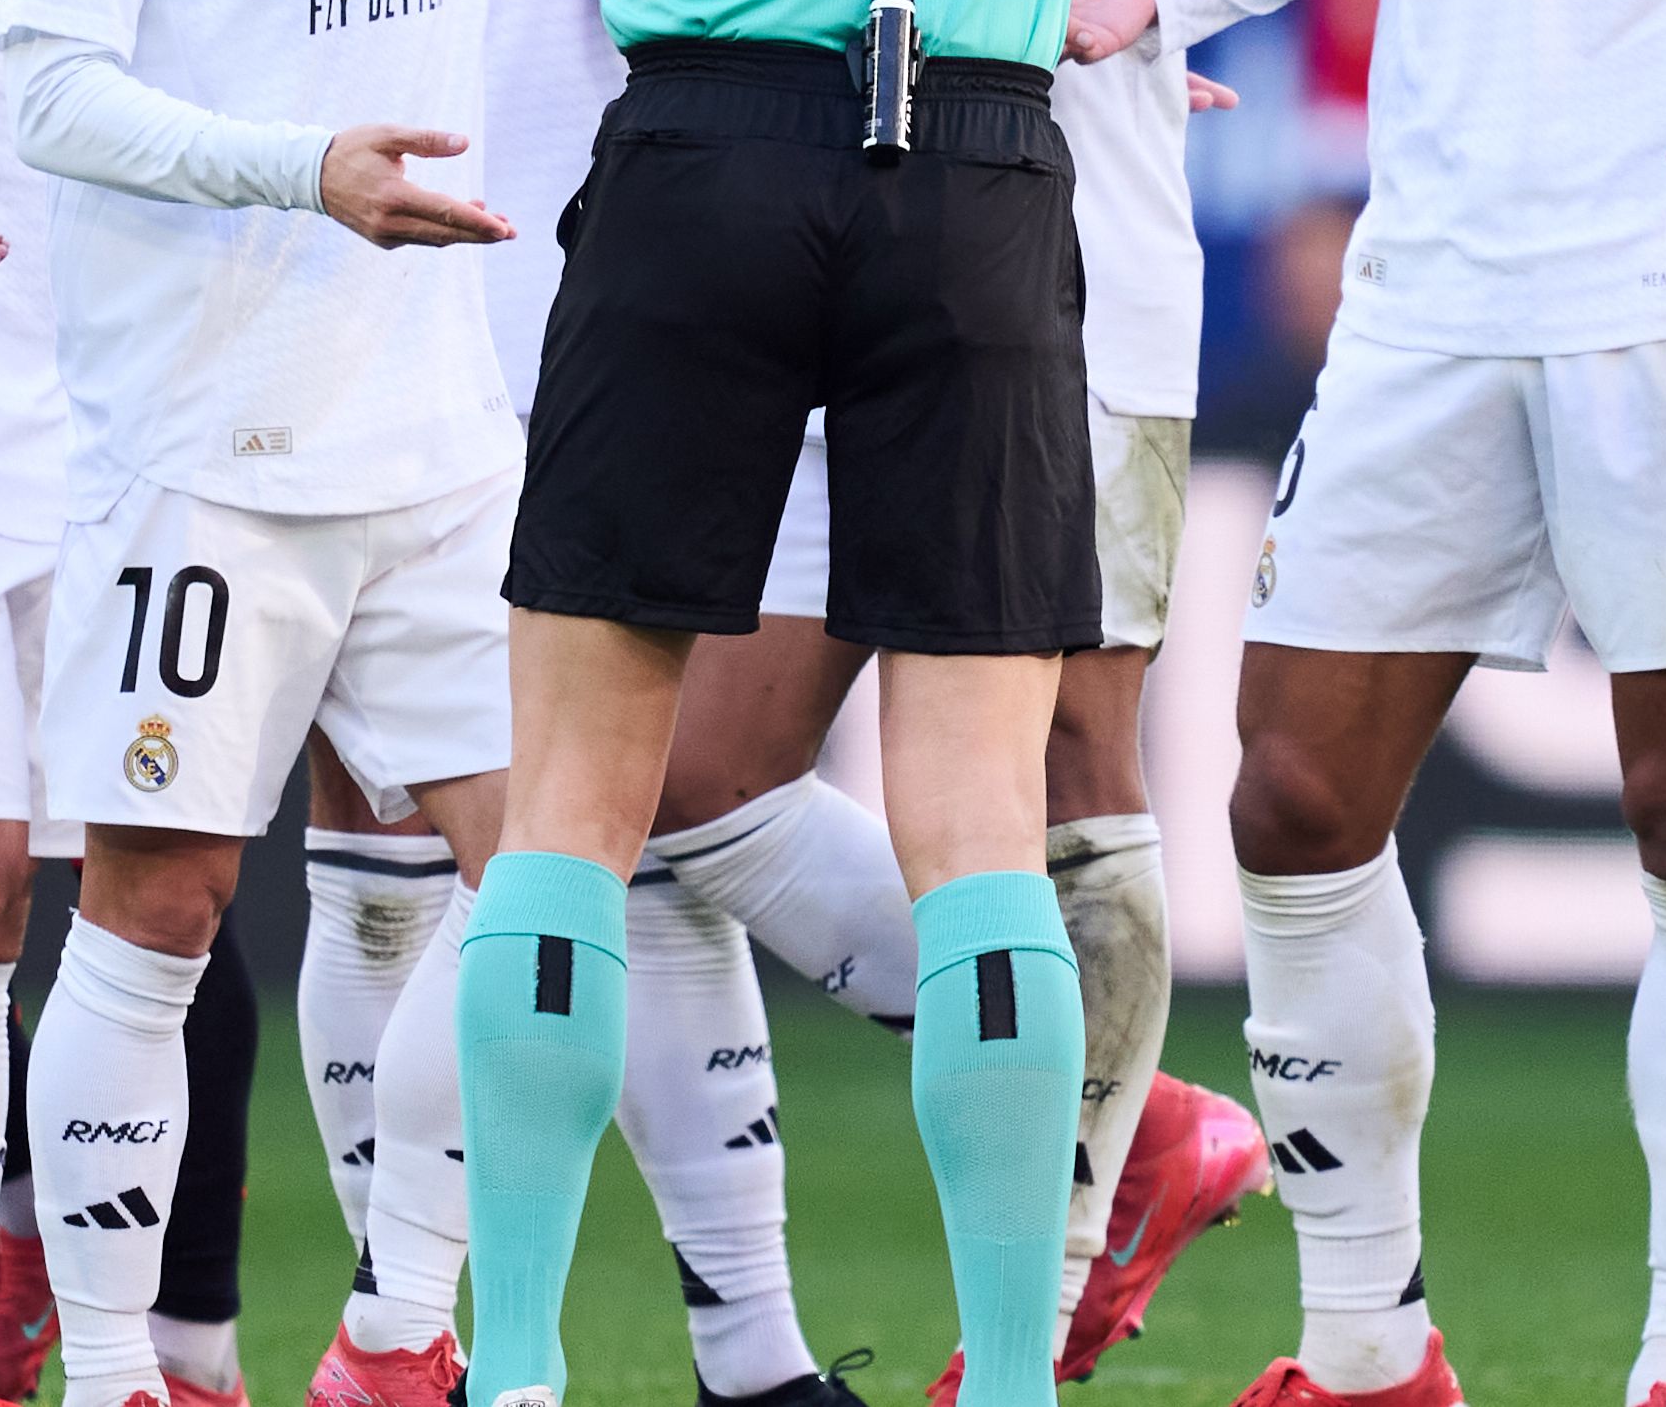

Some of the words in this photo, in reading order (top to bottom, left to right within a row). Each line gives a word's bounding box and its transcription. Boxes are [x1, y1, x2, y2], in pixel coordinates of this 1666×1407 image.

[116, 565, 230, 698] 10
[823, 955, 855, 994] CF
[323, 1061, 375, 1084] RM
[1248, 1047, 1342, 1082] MCF
[1082, 1078, 1121, 1103] CF
[62, 1119, 169, 1143] RMCF
